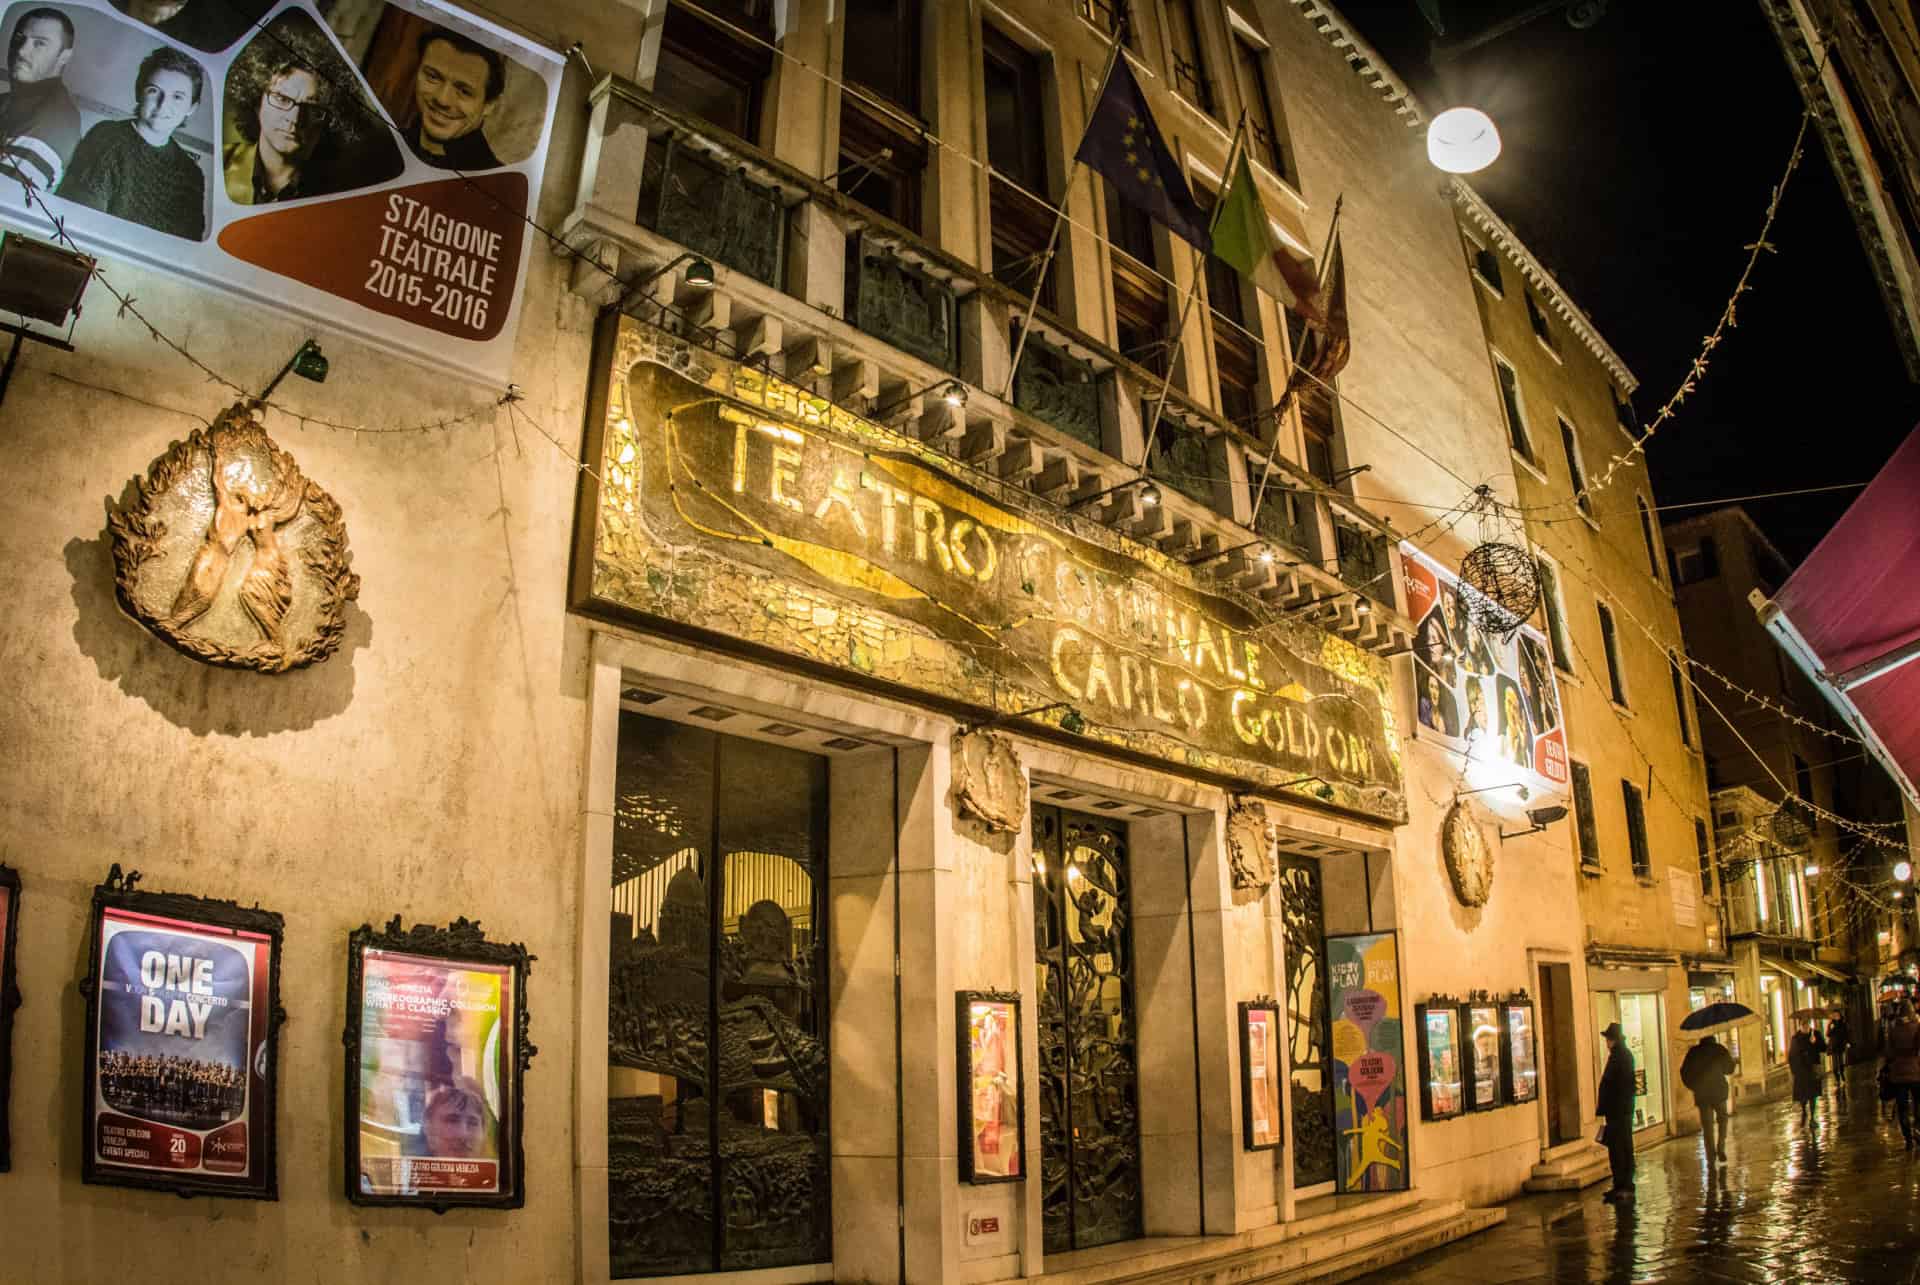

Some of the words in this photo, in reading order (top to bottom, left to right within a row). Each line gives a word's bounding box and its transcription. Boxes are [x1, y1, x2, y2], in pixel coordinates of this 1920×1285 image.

[385, 194, 502, 263] STAGIONE
[379, 225, 497, 297] TEATRALE
[365, 259, 489, 331] 2015-2016
[718, 403, 998, 582] TEATRO
[1051, 628, 1208, 732] CARLO
[141, 950, 214, 996] ONE
[1332, 973, 1360, 989] PLAY
[1368, 969, 1395, 984] PLAY
[140, 995, 213, 1041] DAY
[187, 993, 228, 1007] CONCERTO
[366, 999, 394, 1010] WHAT
[170, 1138, 187, 1153] 20
